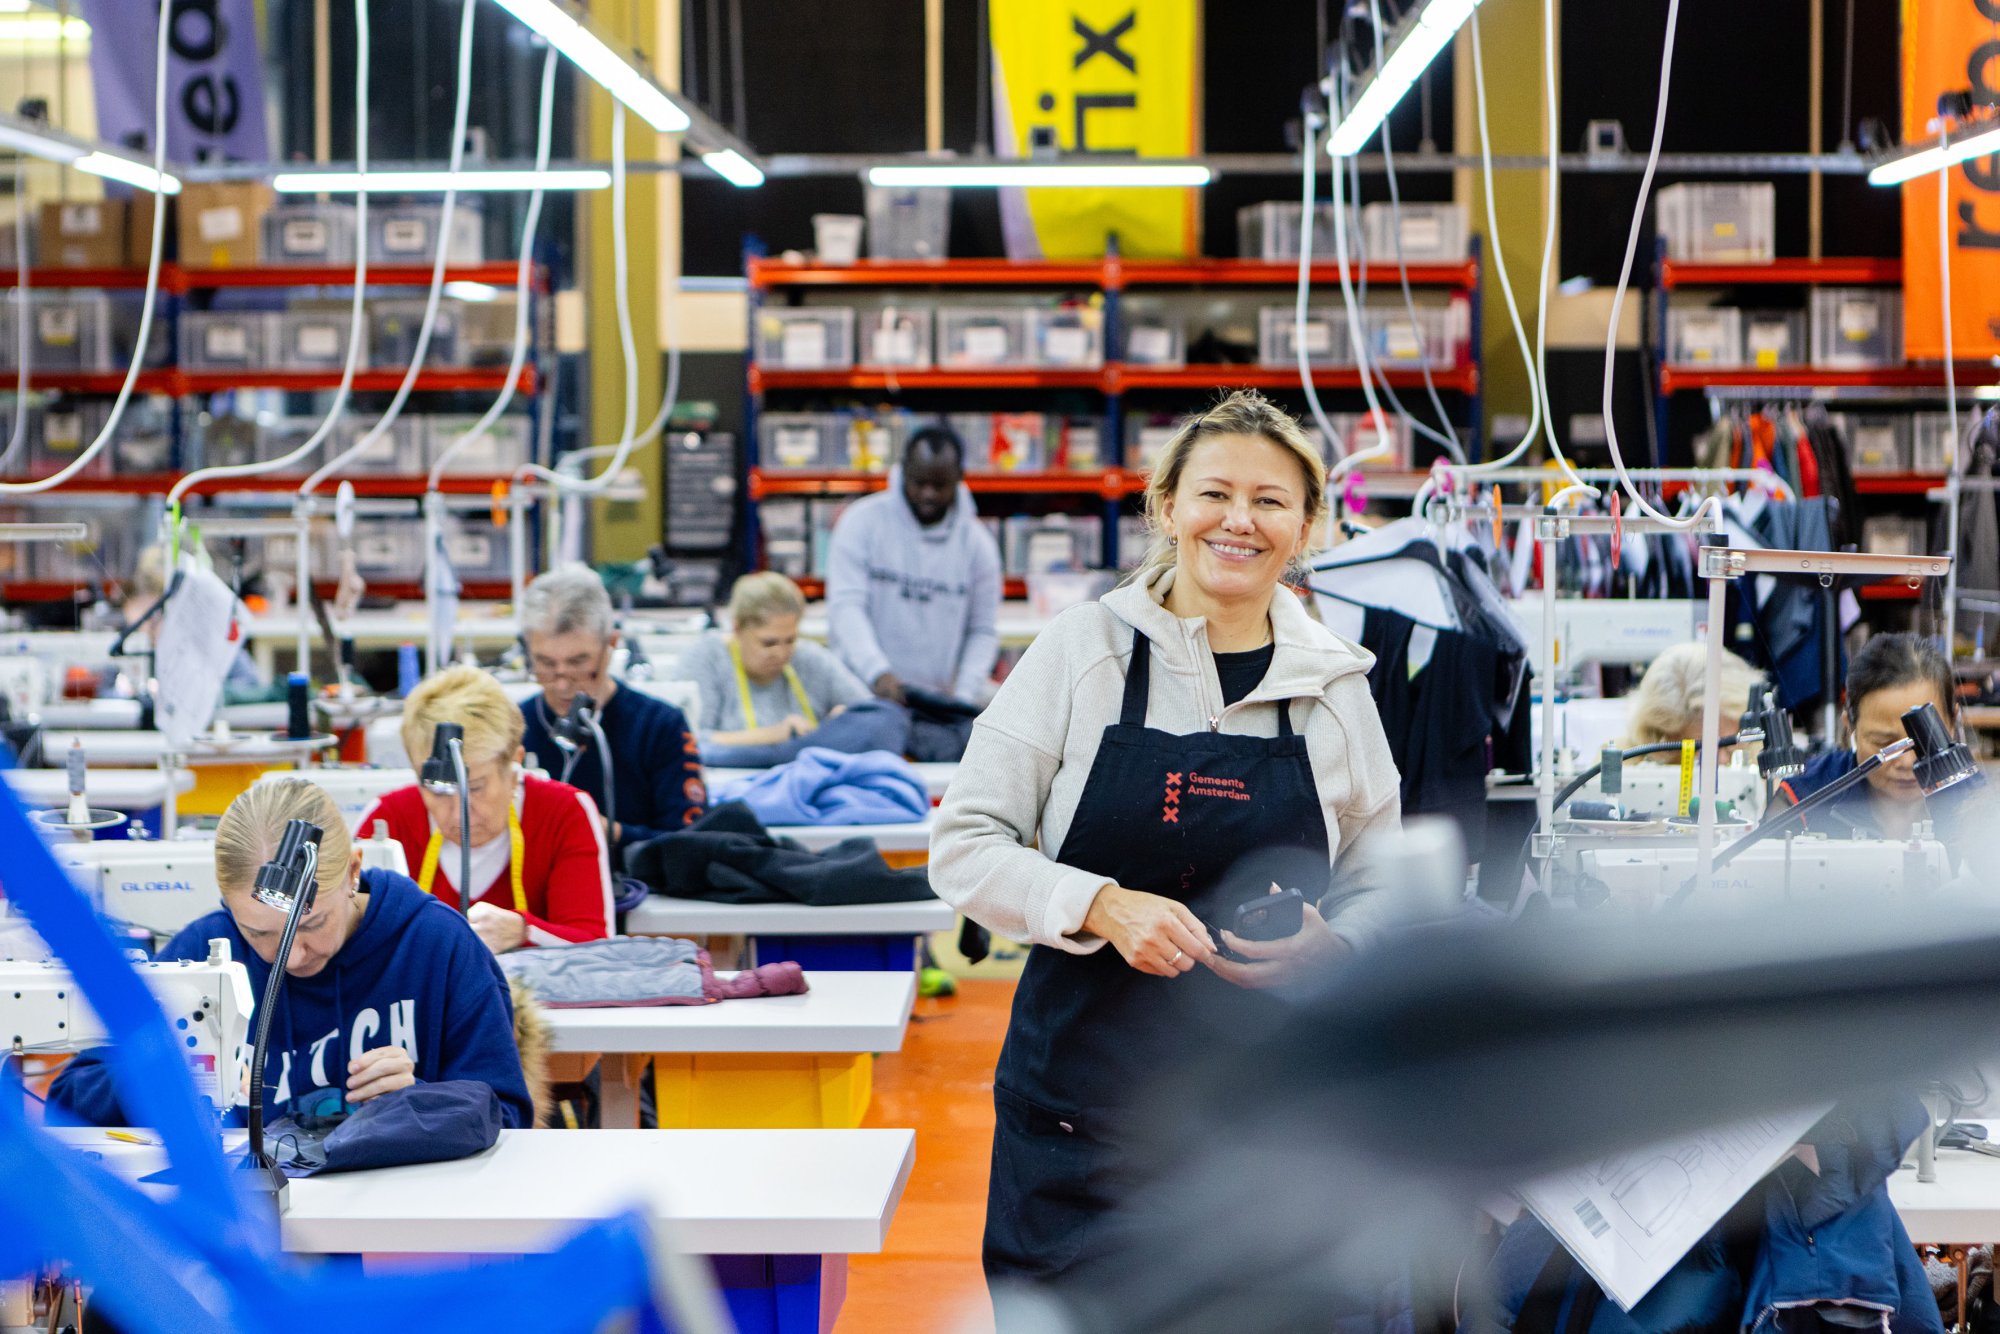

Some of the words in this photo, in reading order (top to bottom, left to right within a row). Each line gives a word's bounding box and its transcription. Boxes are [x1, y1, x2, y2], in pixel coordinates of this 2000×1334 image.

[1189, 772, 1246, 789] Gemeente
[1188, 785, 1251, 801] Amsterdam
[121, 881, 196, 892] GLOBAL
